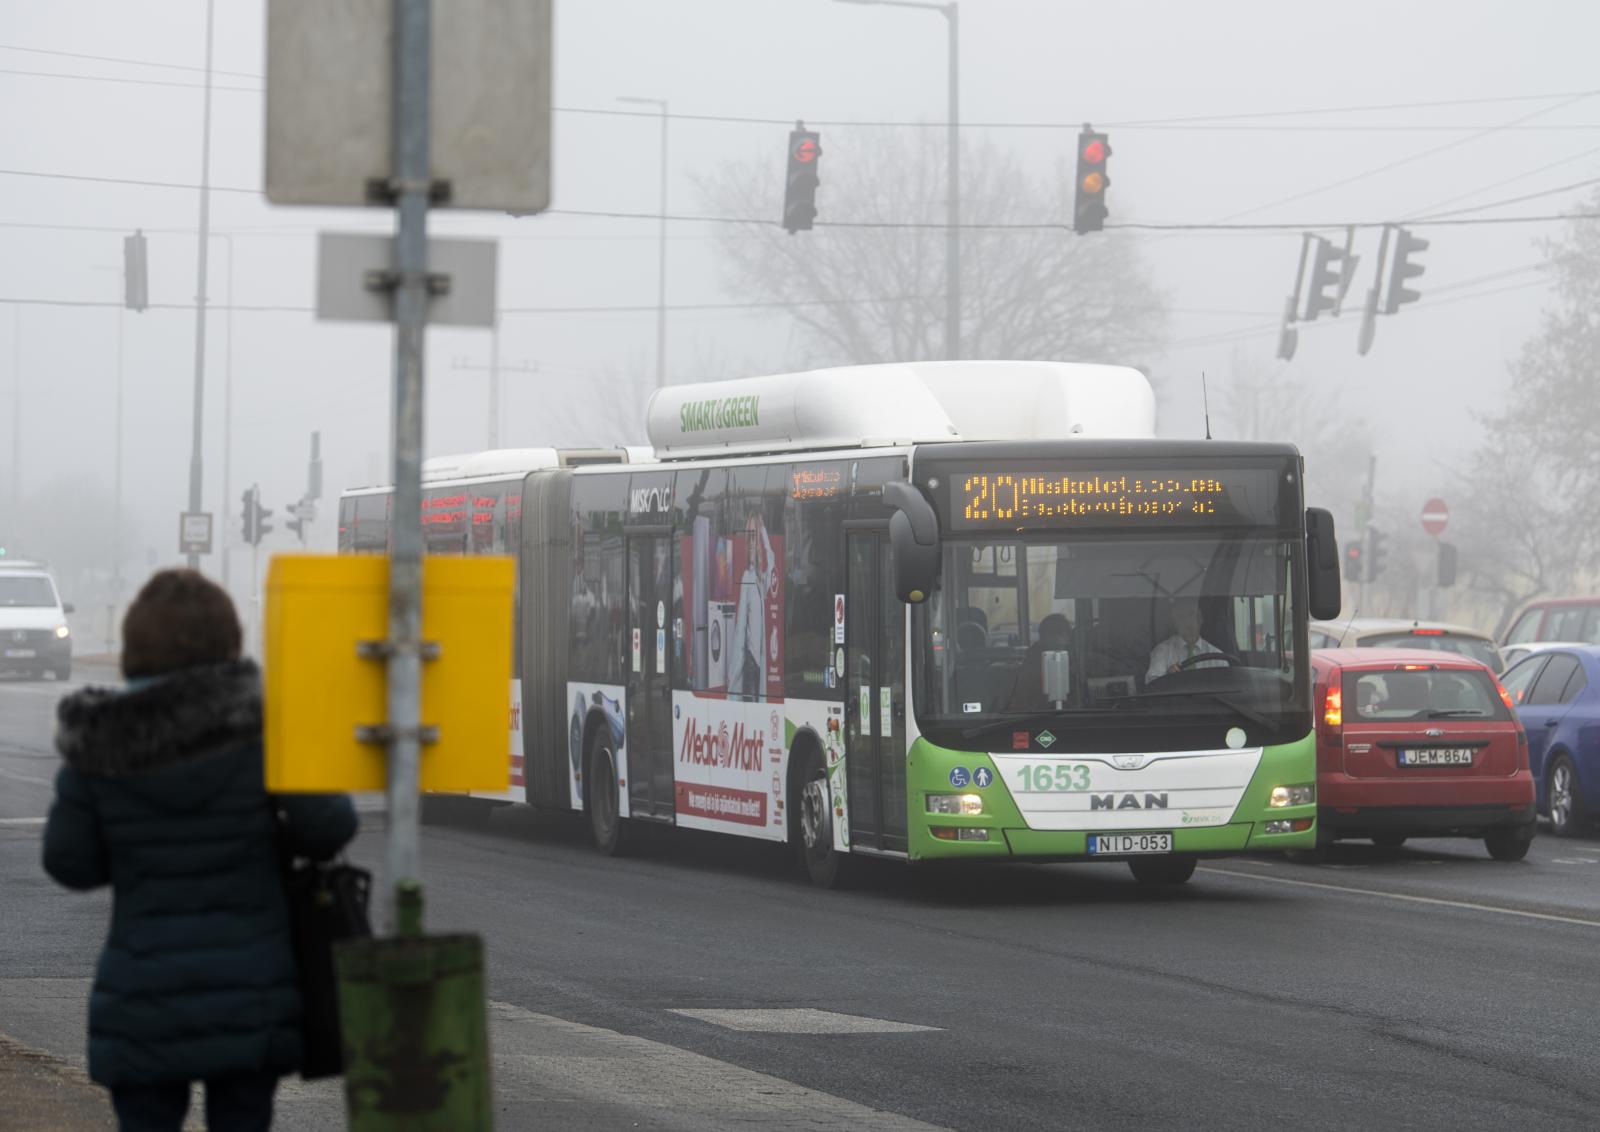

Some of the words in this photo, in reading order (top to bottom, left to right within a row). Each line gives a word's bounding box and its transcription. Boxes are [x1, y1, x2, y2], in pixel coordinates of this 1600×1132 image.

[680, 396, 760, 432] SMART&GREEN
[964, 476, 1018, 519] 20
[680, 717, 720, 767] Media
[727, 721, 764, 772] Markt
[1408, 750, 1470, 764] JEM-864
[1017, 764, 1091, 791] 1653
[1090, 793, 1168, 810] MAN
[1099, 835, 1169, 851] NID-053
